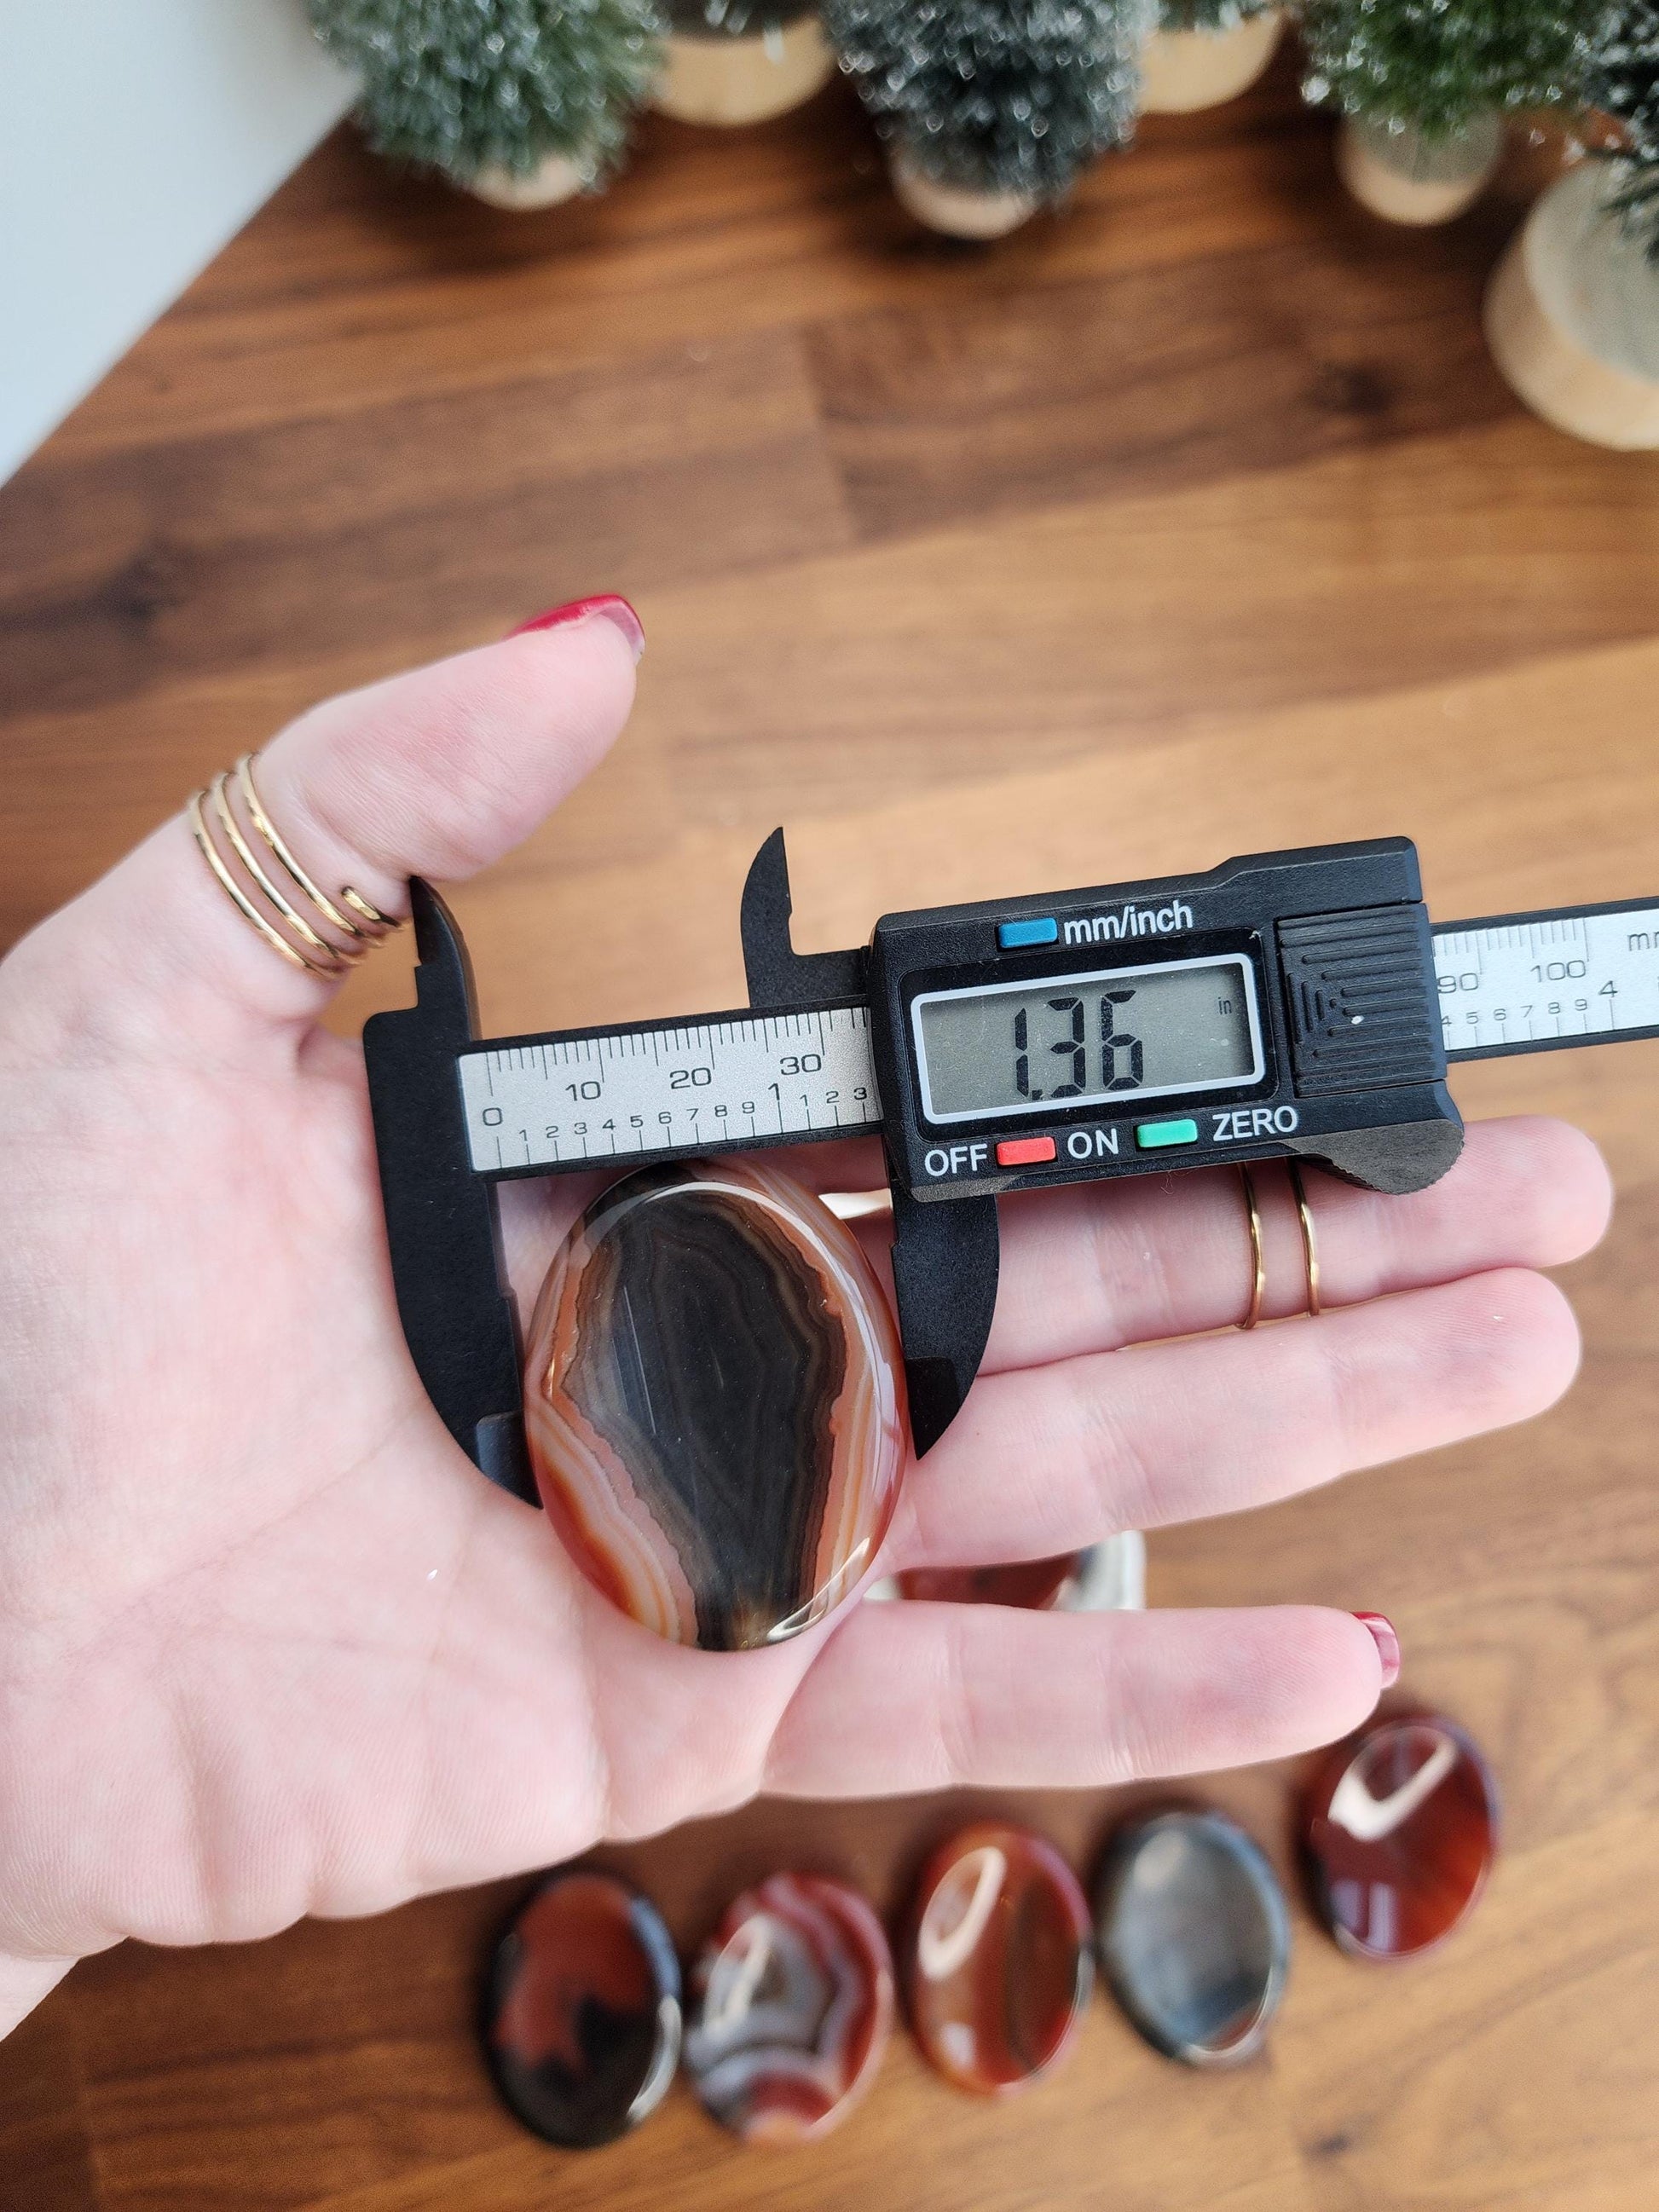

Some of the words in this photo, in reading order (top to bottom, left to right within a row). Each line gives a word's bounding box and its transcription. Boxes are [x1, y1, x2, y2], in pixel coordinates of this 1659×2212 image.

[1063, 899, 1194, 944] mm/inch
[1437, 973, 1479, 994] 90
[1530, 960, 1587, 983] 100
[1598, 980, 1618, 997] 4
[1218, 996, 1233, 1016] in
[1465, 1012, 1479, 1024] 5
[1493, 1008, 1507, 1021] 6
[1520, 1005, 1534, 1018] 7
[1547, 1002, 1561, 1014] 8
[1575, 998, 1587, 1011] 9
[1014, 989, 1144, 1100] 1.36
[483, 1107, 504, 1127] 0
[565, 1081, 602, 1102] 10
[669, 1067, 713, 1090] 20
[779, 1054, 823, 1076] 30
[767, 1083, 782, 1101] 1
[800, 1094, 809, 1106] 1
[825, 1090, 840, 1104] 2
[853, 1087, 868, 1100] 3
[518, 1129, 529, 1142] 1
[546, 1125, 560, 1139] 2
[574, 1122, 588, 1135] 3
[602, 1118, 616, 1131] 4
[630, 1115, 644, 1128] 5
[657, 1112, 672, 1124] 6
[686, 1108, 700, 1121] 7
[714, 1105, 728, 1118] 8
[742, 1101, 755, 1114] 9
[924, 1143, 988, 1177] OFF
[1067, 1128, 1119, 1159] ON
[1211, 1106, 1298, 1142] ZERO
